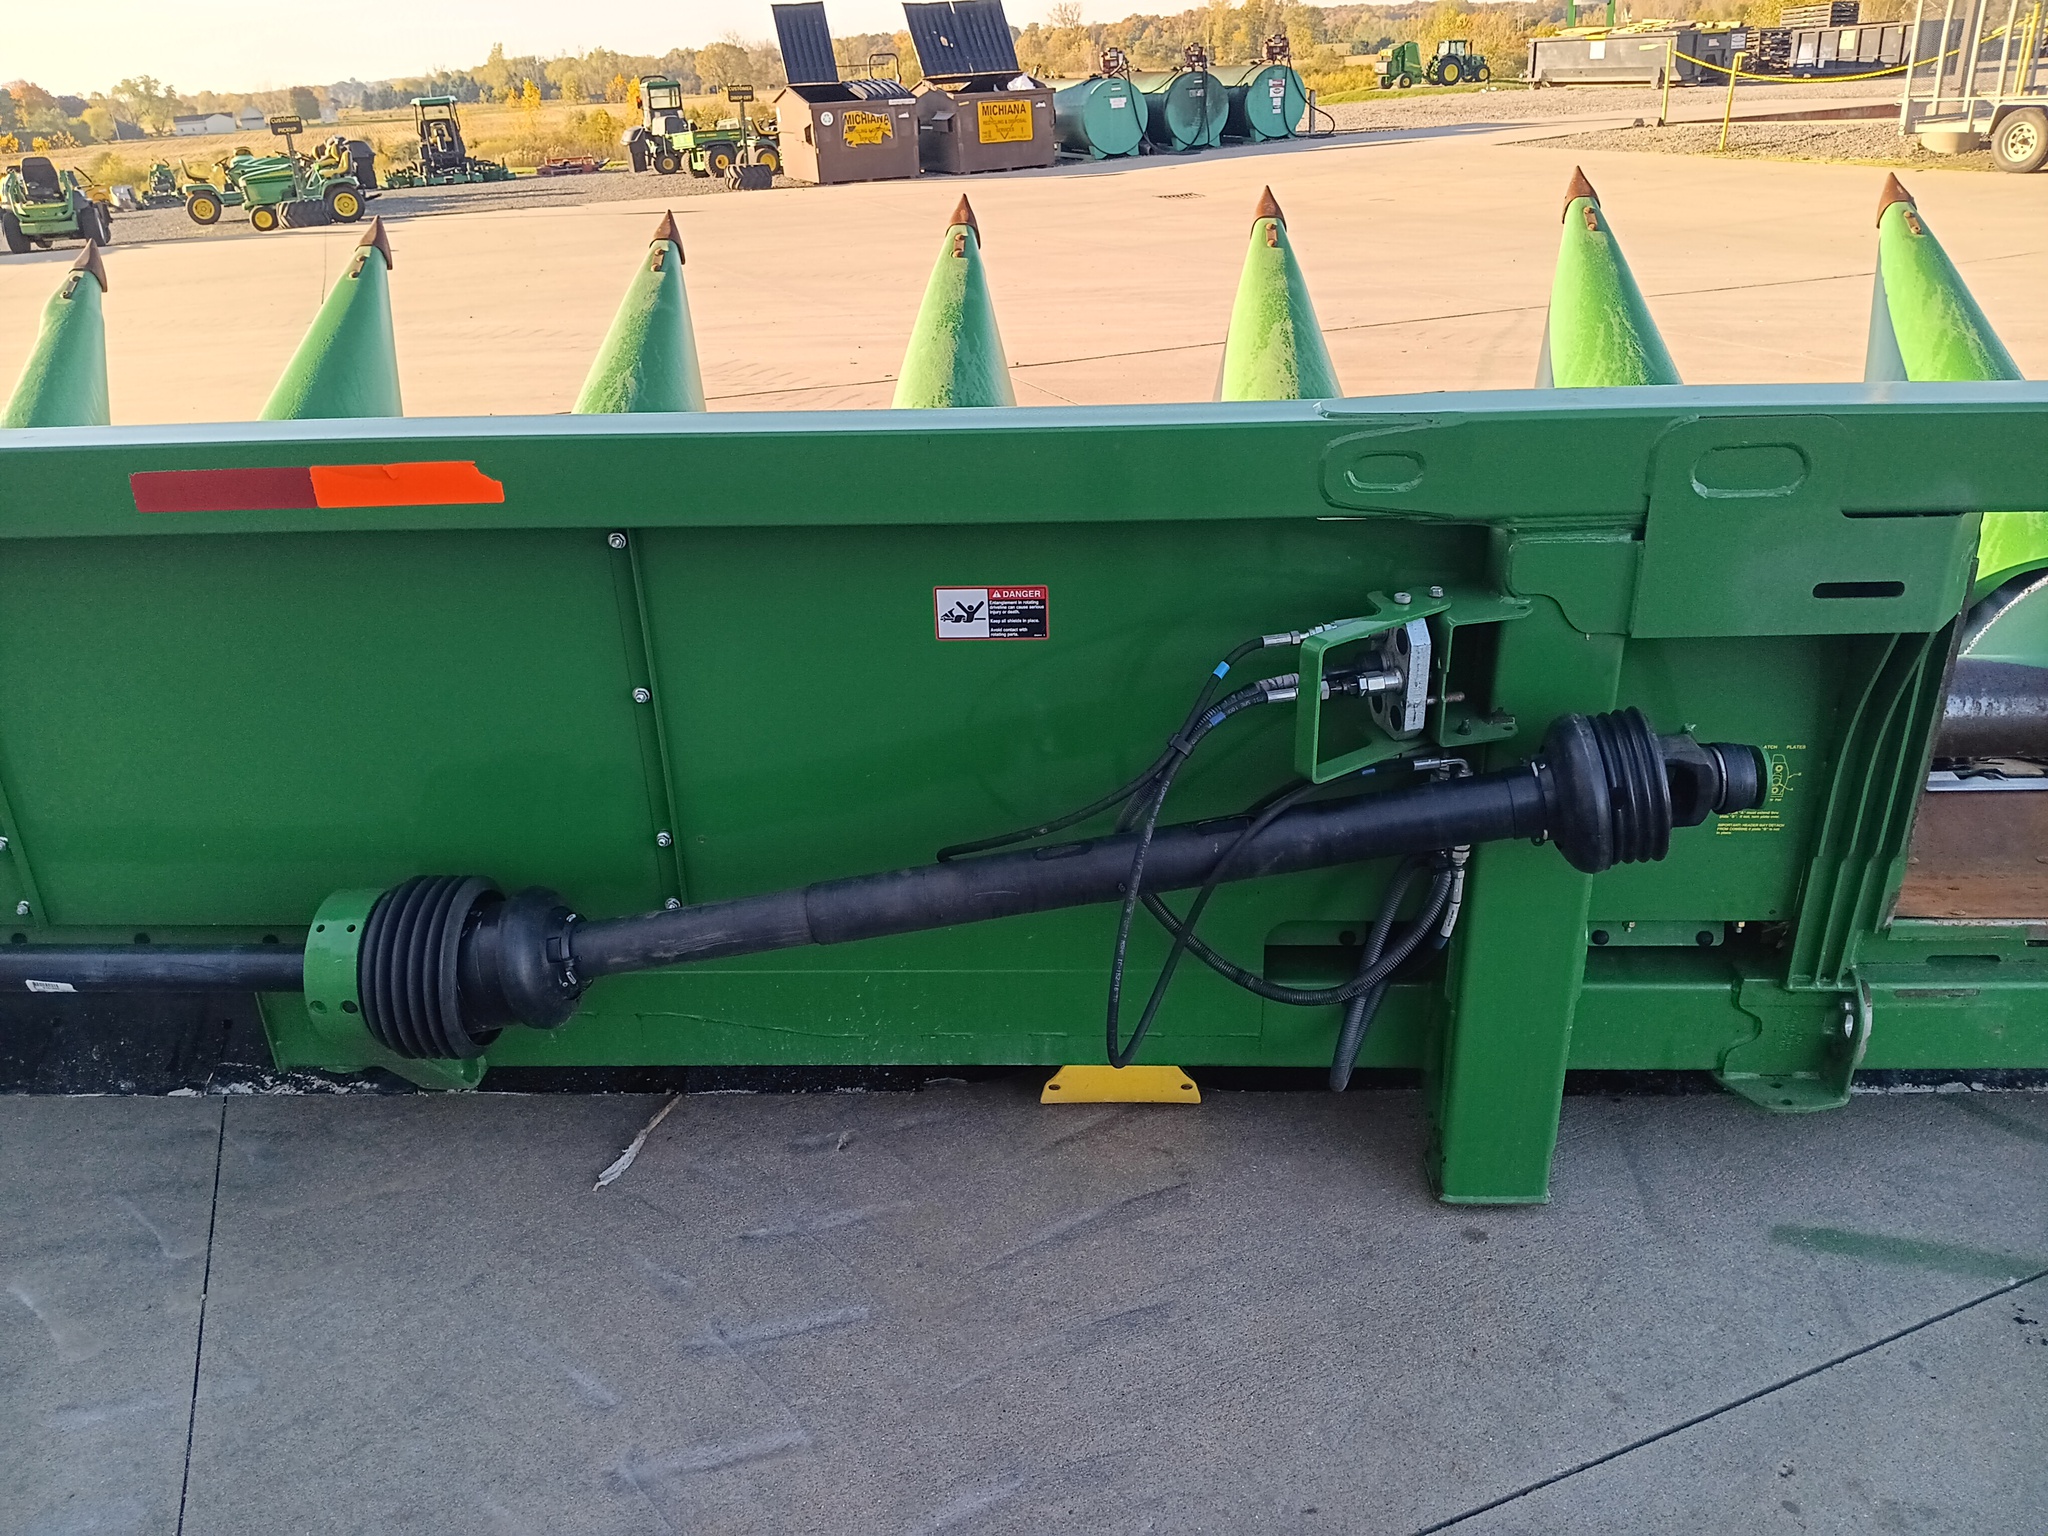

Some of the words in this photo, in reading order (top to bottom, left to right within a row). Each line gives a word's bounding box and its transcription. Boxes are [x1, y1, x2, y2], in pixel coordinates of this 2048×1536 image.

[982, 104, 1027, 116] MICHIANA
[844, 114, 890, 125] MICHIANA
[1002, 590, 1041, 598] DANGER
